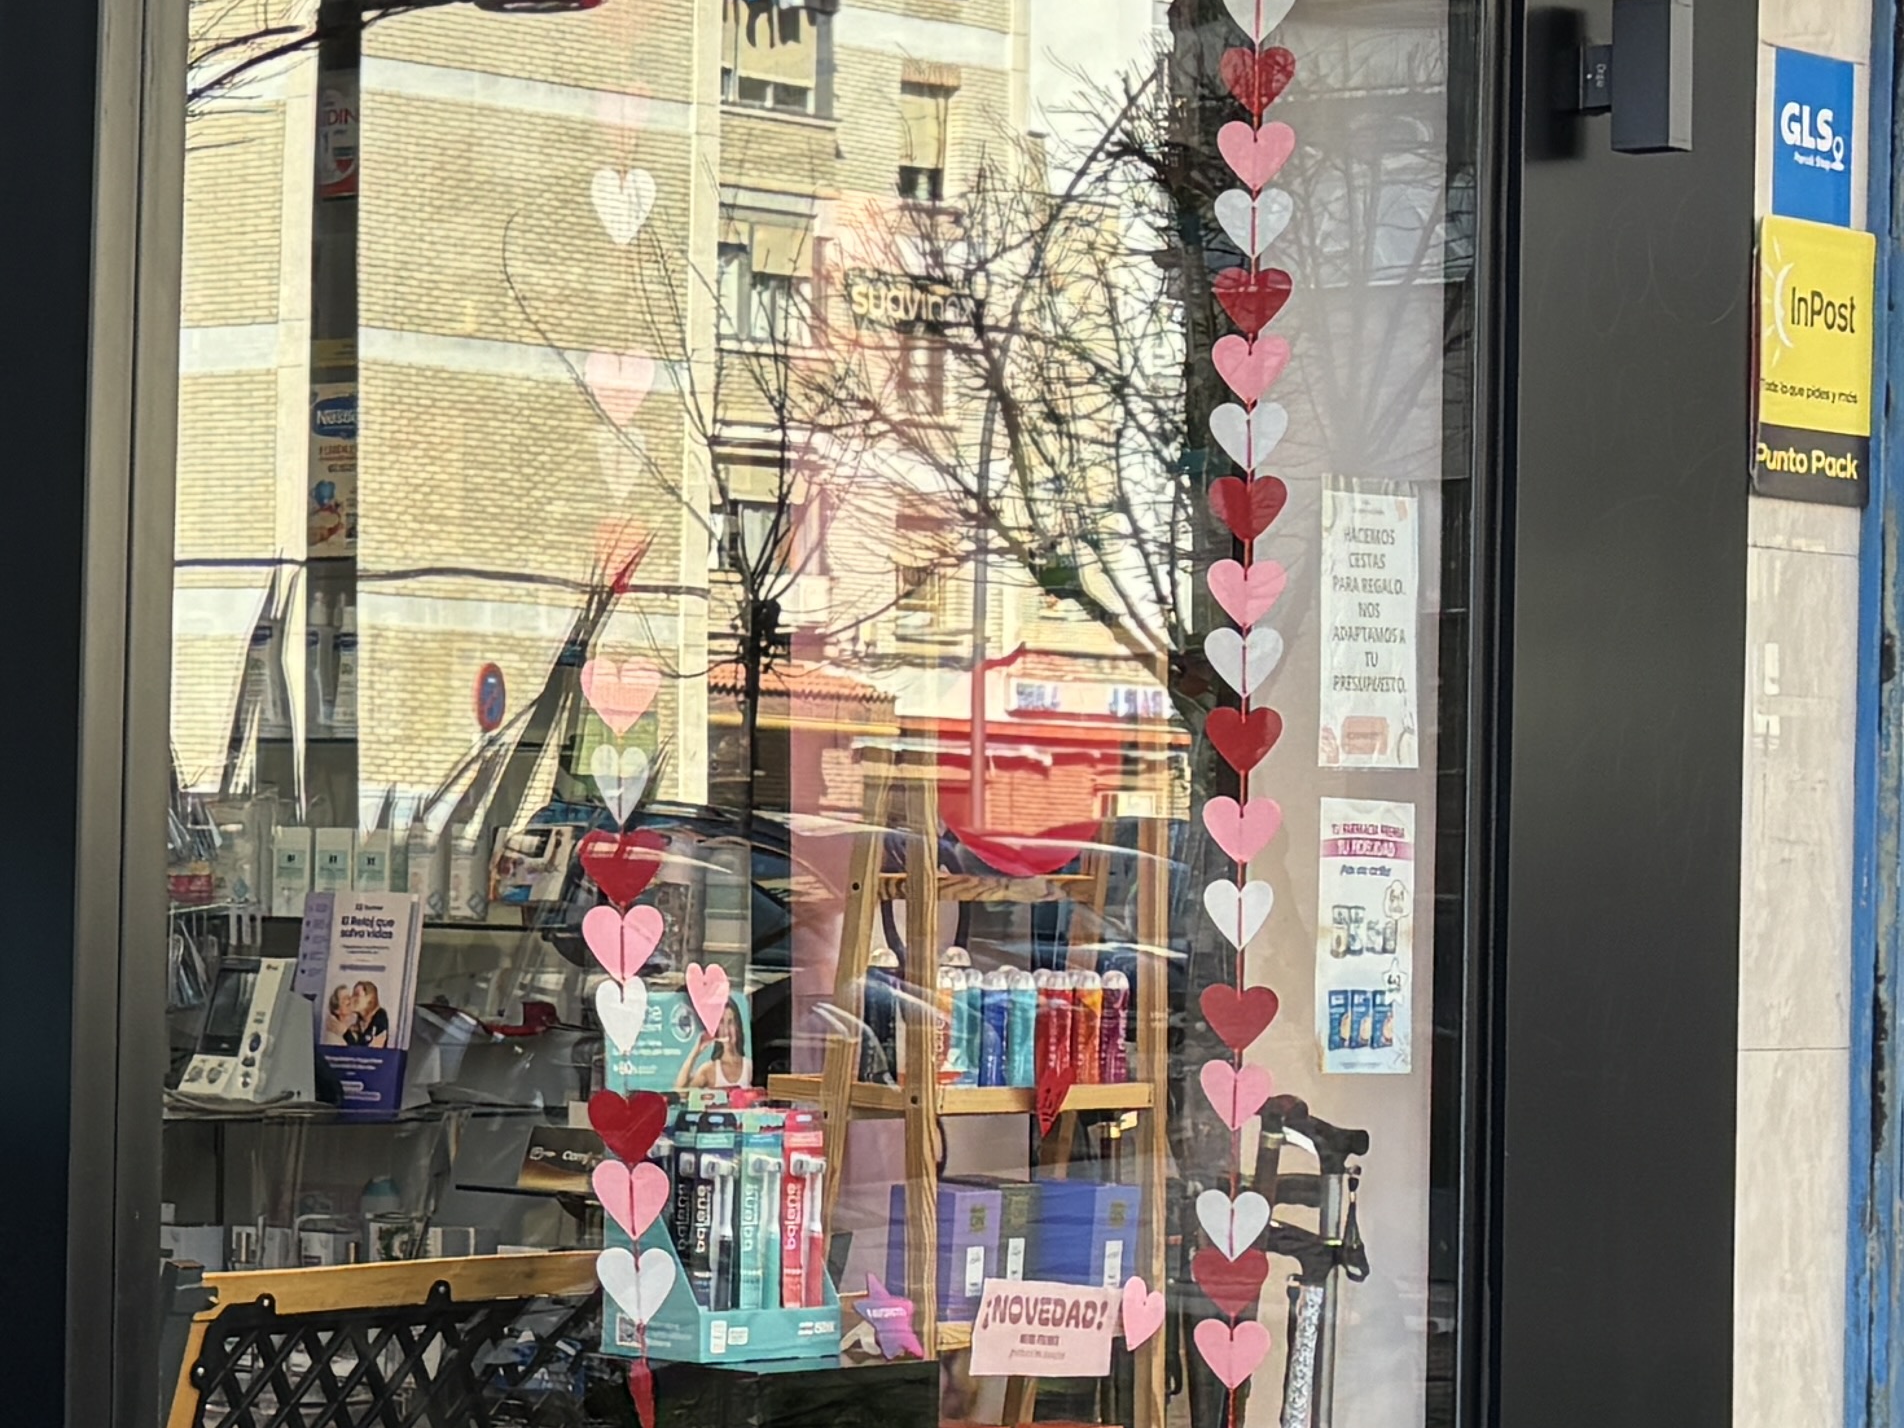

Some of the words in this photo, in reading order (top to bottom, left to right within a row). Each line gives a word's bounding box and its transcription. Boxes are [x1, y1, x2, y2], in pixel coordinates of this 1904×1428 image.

[1780, 102, 1834, 152] GLS
[1791, 287, 1856, 334] InPost
[1756, 442, 1808, 474] Punto
[1811, 449, 1858, 480] Pack
[1344, 527, 1395, 546] HACEMOS
[1349, 553, 1386, 570] CESTAS
[1333, 575, 1358, 593] PARA
[1358, 602, 1381, 618] NOS
[1332, 627, 1397, 644] ADAPTAMOS
[1399, 628, 1406, 644] A
[1364, 651, 1379, 667] TU
[784, 1183, 801, 1251] balene
[981, 1293, 1109, 1330] ¡NOVEDAD!
